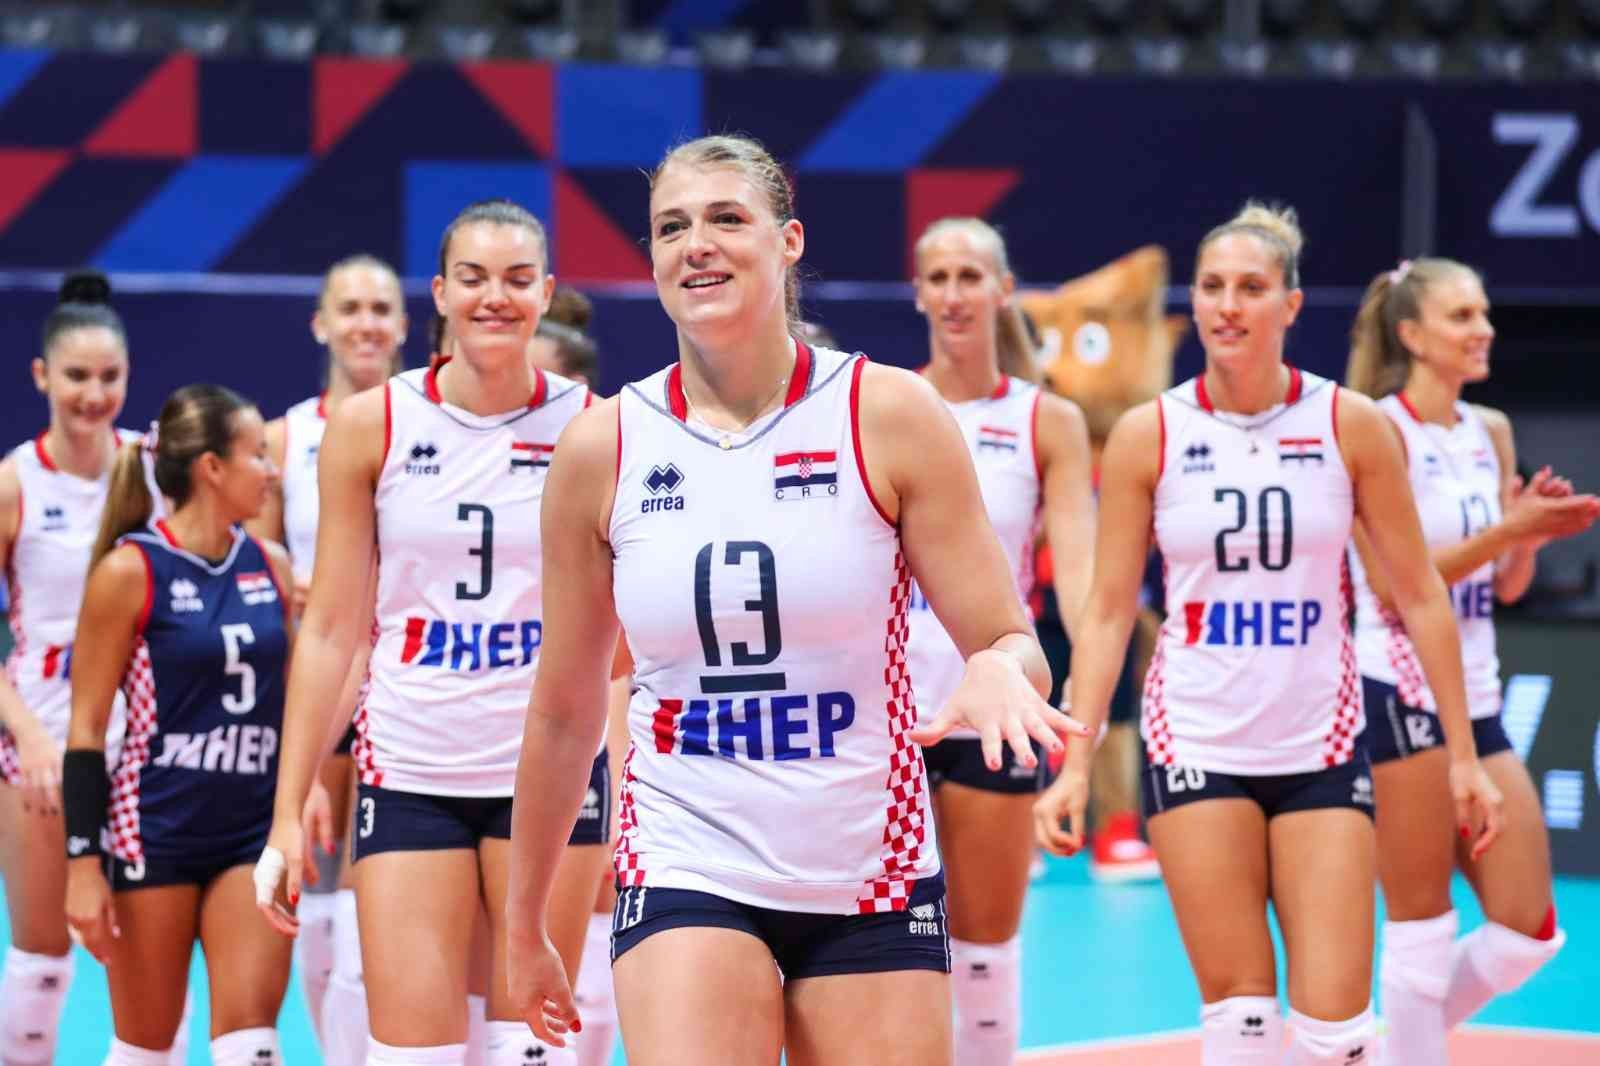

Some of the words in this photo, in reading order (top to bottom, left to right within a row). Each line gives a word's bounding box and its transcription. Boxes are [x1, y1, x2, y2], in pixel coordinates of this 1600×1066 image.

[1490, 111, 1600, 240] Z
[641, 494, 685, 514] errea
[1214, 486, 1293, 573] 20
[456, 503, 494, 601] 3
[694, 540, 783, 668] 13
[1233, 601, 1322, 646] HEP
[220, 622, 256, 714] 5
[449, 620, 542, 671] HEP
[203, 724, 278, 774] HEP
[716, 690, 856, 761] HEP
[360, 797, 375, 839] 3
[908, 920, 939, 936] errea
